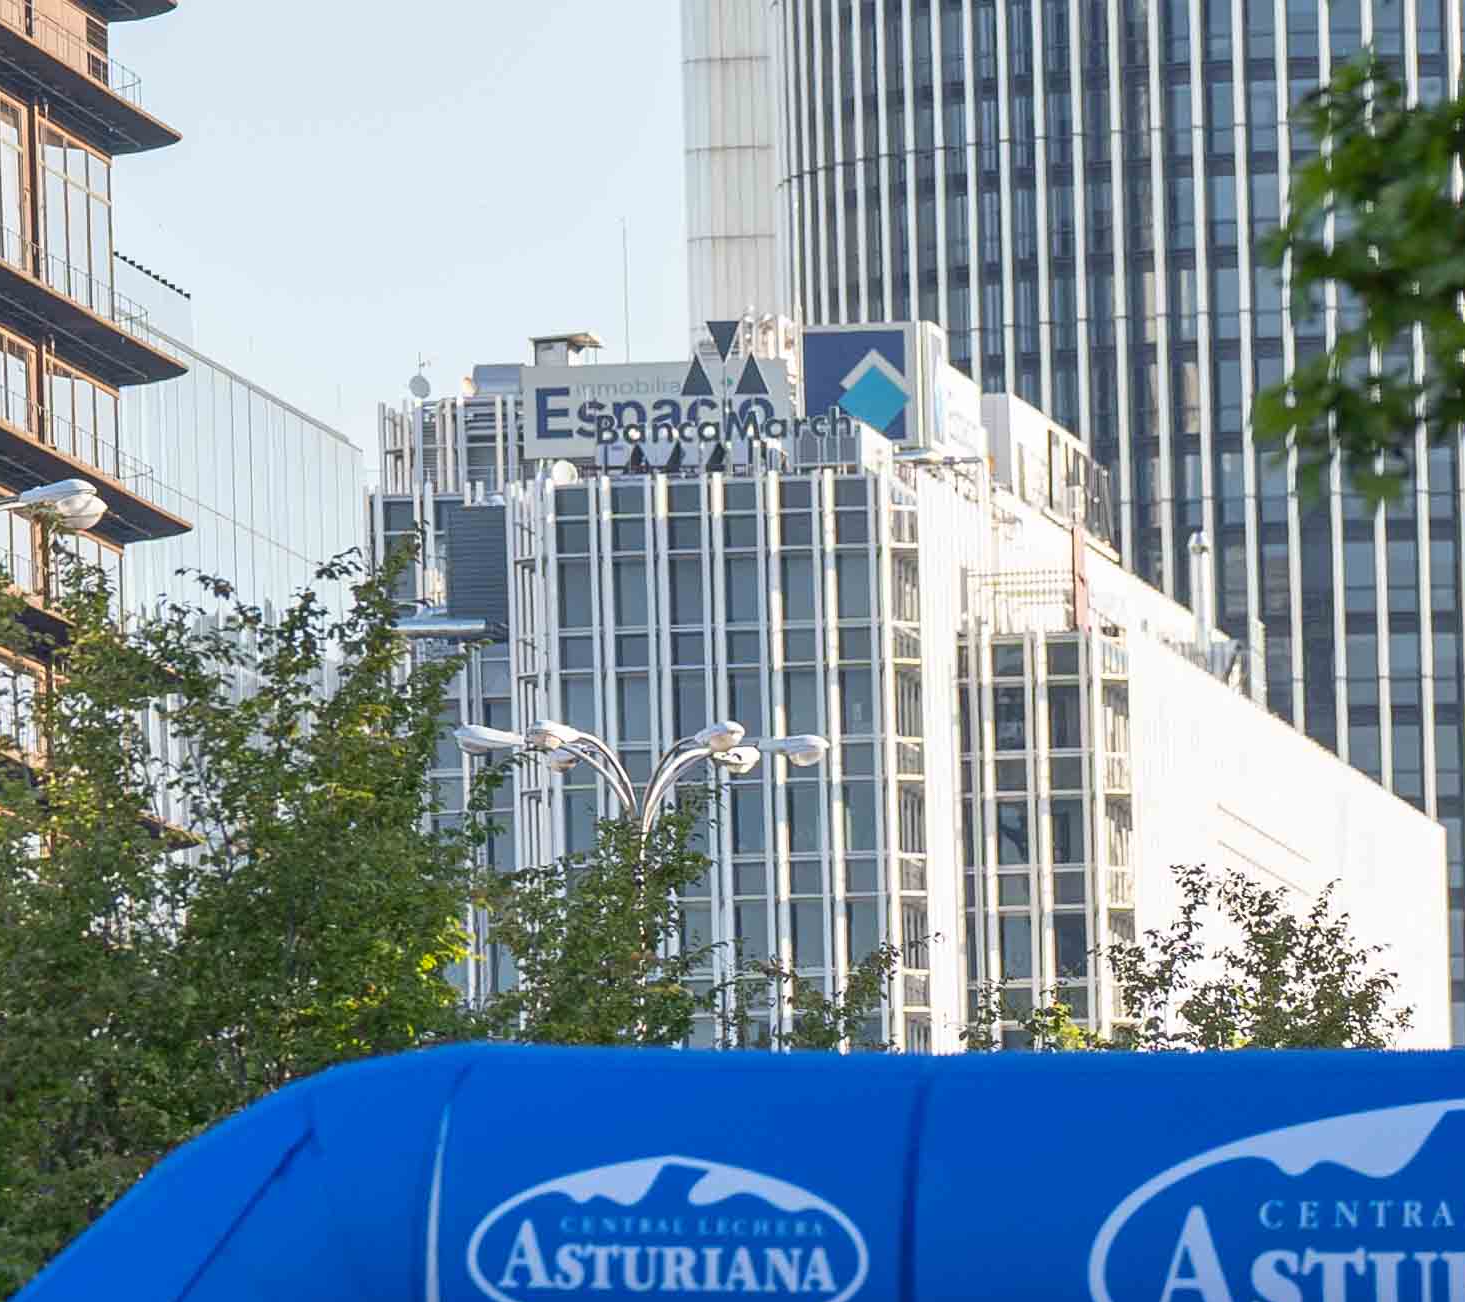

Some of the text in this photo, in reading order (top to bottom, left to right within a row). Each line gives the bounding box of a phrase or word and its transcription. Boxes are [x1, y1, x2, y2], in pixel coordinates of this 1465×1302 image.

[561, 1215, 825, 1237] CENTRAL LECHERA
[499, 1219, 838, 1293] ASTURIANA
